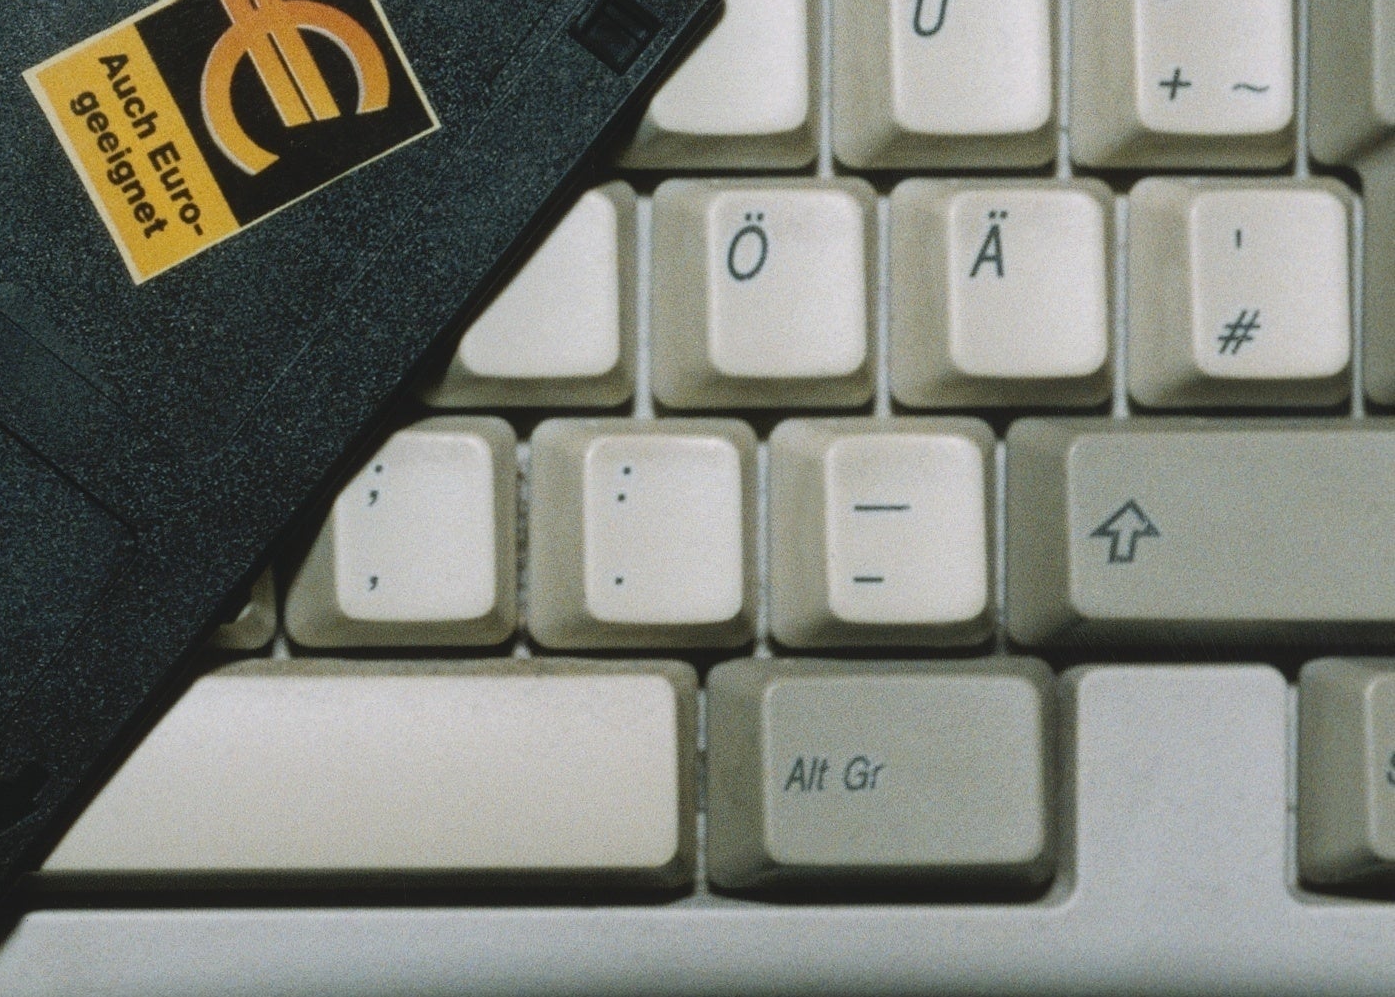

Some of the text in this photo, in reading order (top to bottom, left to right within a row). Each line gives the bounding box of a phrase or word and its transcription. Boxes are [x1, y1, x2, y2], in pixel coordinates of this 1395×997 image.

[70, 91, 168, 239] geeignet
[98, 52, 205, 236] Auch Euro-
[726, 212, 769, 283] Ö
[969, 210, 1009, 279] Ä
[1217, 309, 1261, 355] #
[783, 755, 885, 793] Alt Gr
